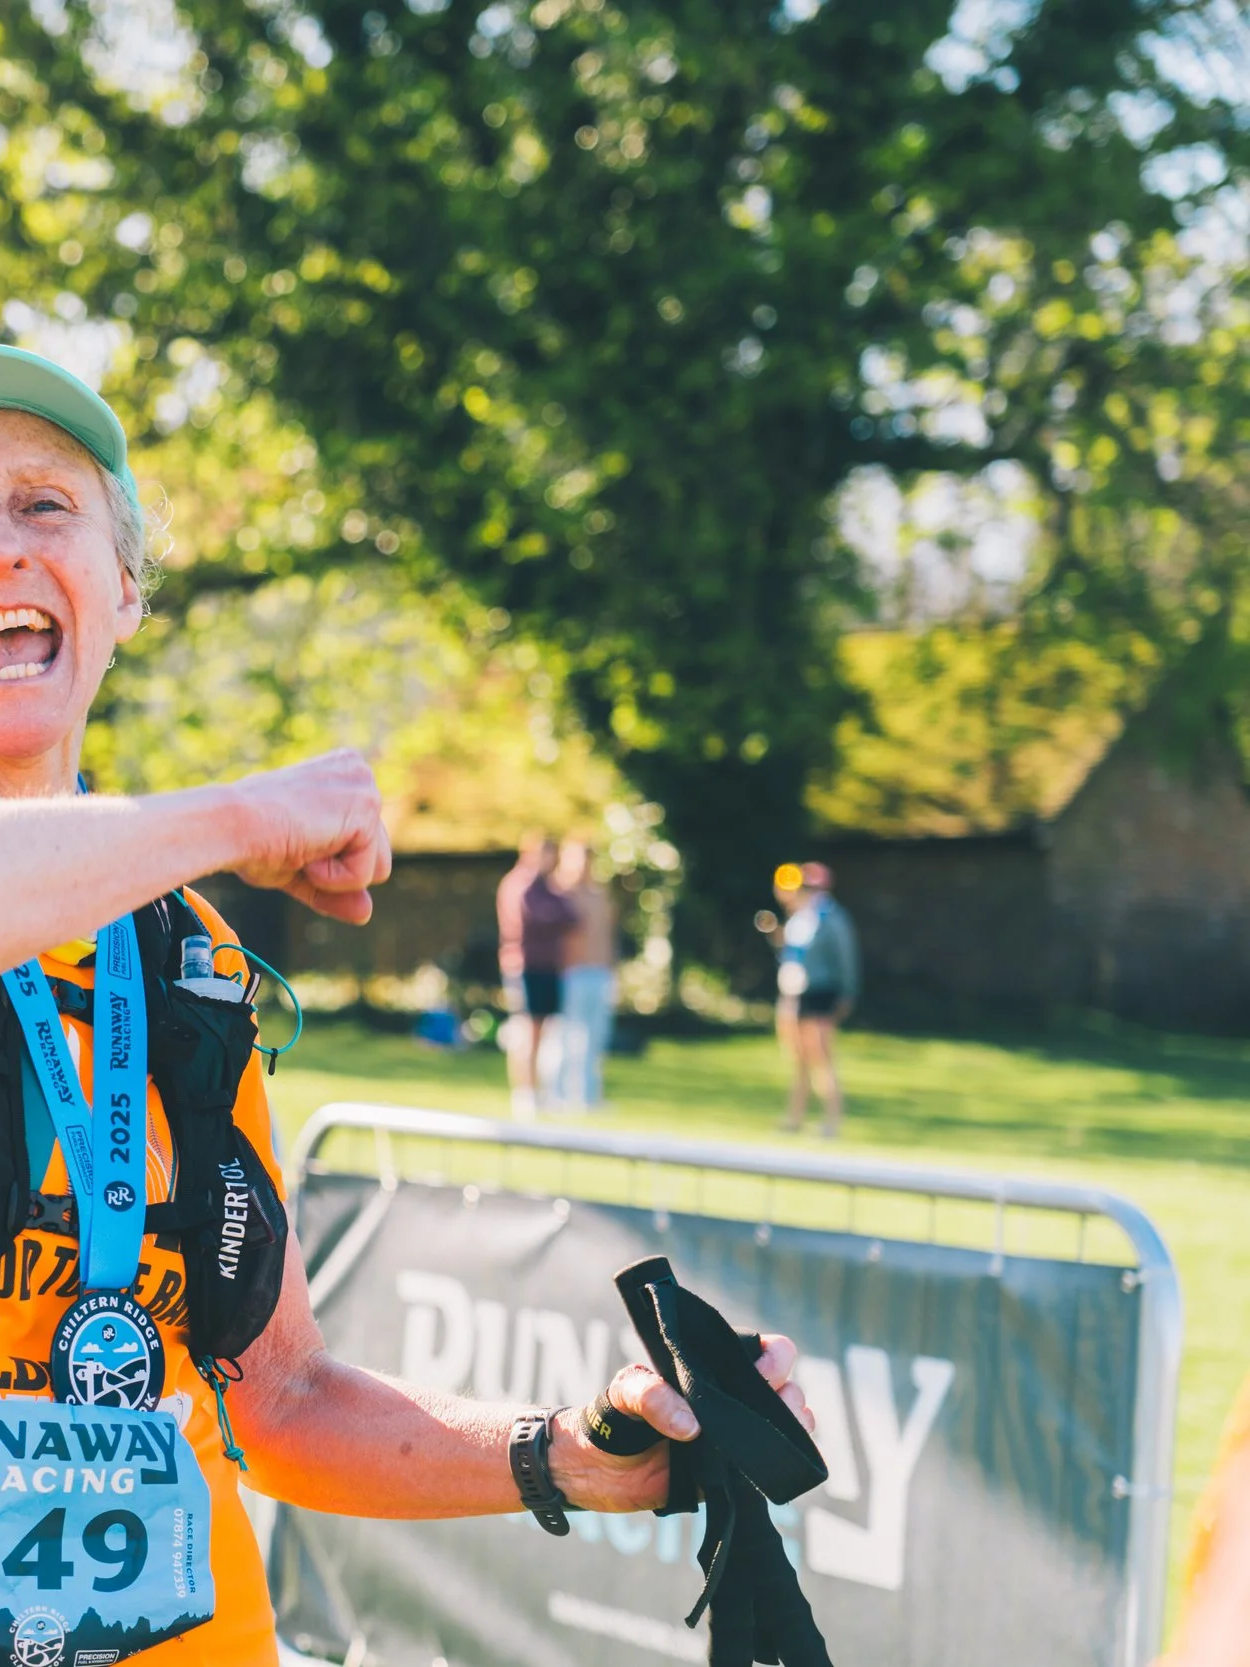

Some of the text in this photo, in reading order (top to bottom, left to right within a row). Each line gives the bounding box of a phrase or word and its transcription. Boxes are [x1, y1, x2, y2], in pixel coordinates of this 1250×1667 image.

[109, 991, 129, 1071] RUNAWAY
[122, 1006, 132, 1053] RACING
[35, 1018, 76, 1106] RUNAWAY
[39, 1042, 61, 1089] RACING
[109, 1092, 132, 1164] 2025
[76, 1130, 93, 1184] PRECISI
[58, 1296, 160, 1351] CHILTERN RIDGE
[172, 1508, 187, 1598] 07874 947339
[186, 1543, 196, 1593] DIRECTOR
